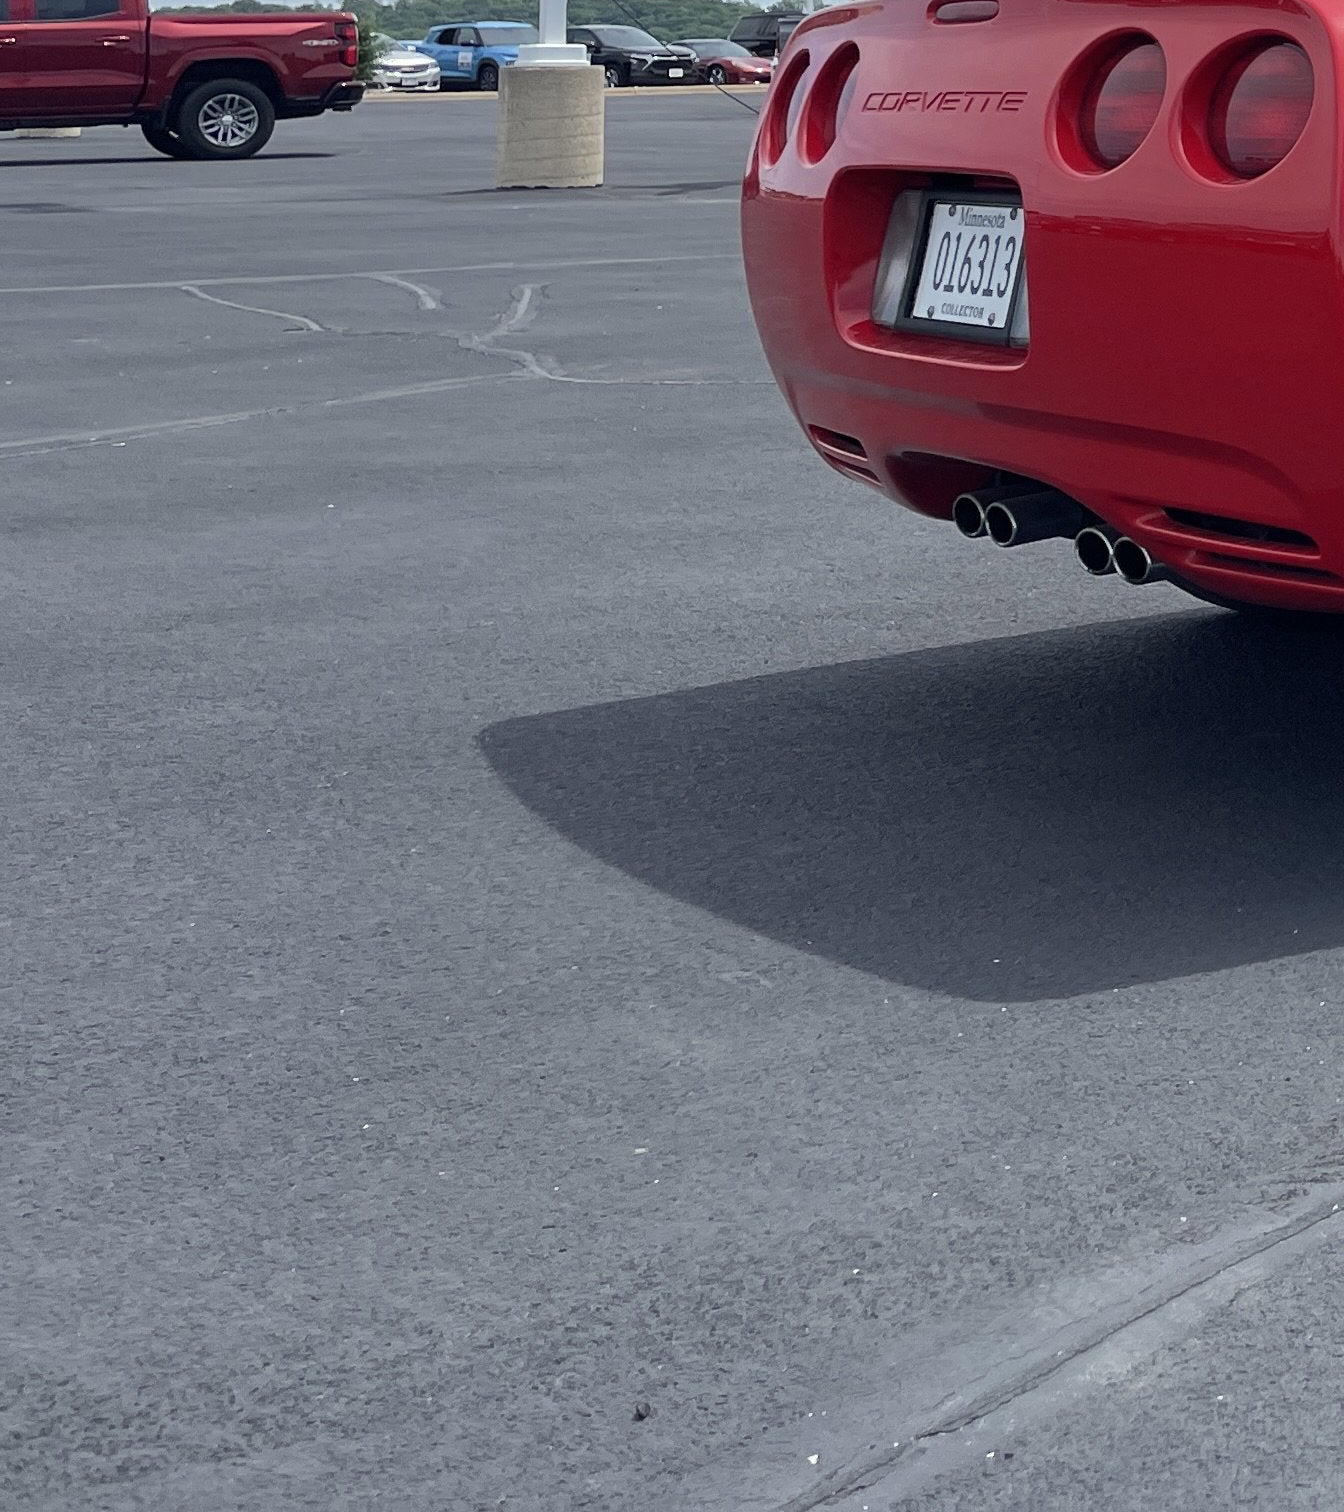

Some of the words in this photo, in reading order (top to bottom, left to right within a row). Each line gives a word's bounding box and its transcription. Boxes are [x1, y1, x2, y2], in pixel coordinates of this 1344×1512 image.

[862, 91, 1028, 113] CORVETTE
[958, 206, 1006, 229] Minnesota
[933, 231, 1017, 298] 016313
[940, 302, 985, 320] COLLECTOR
